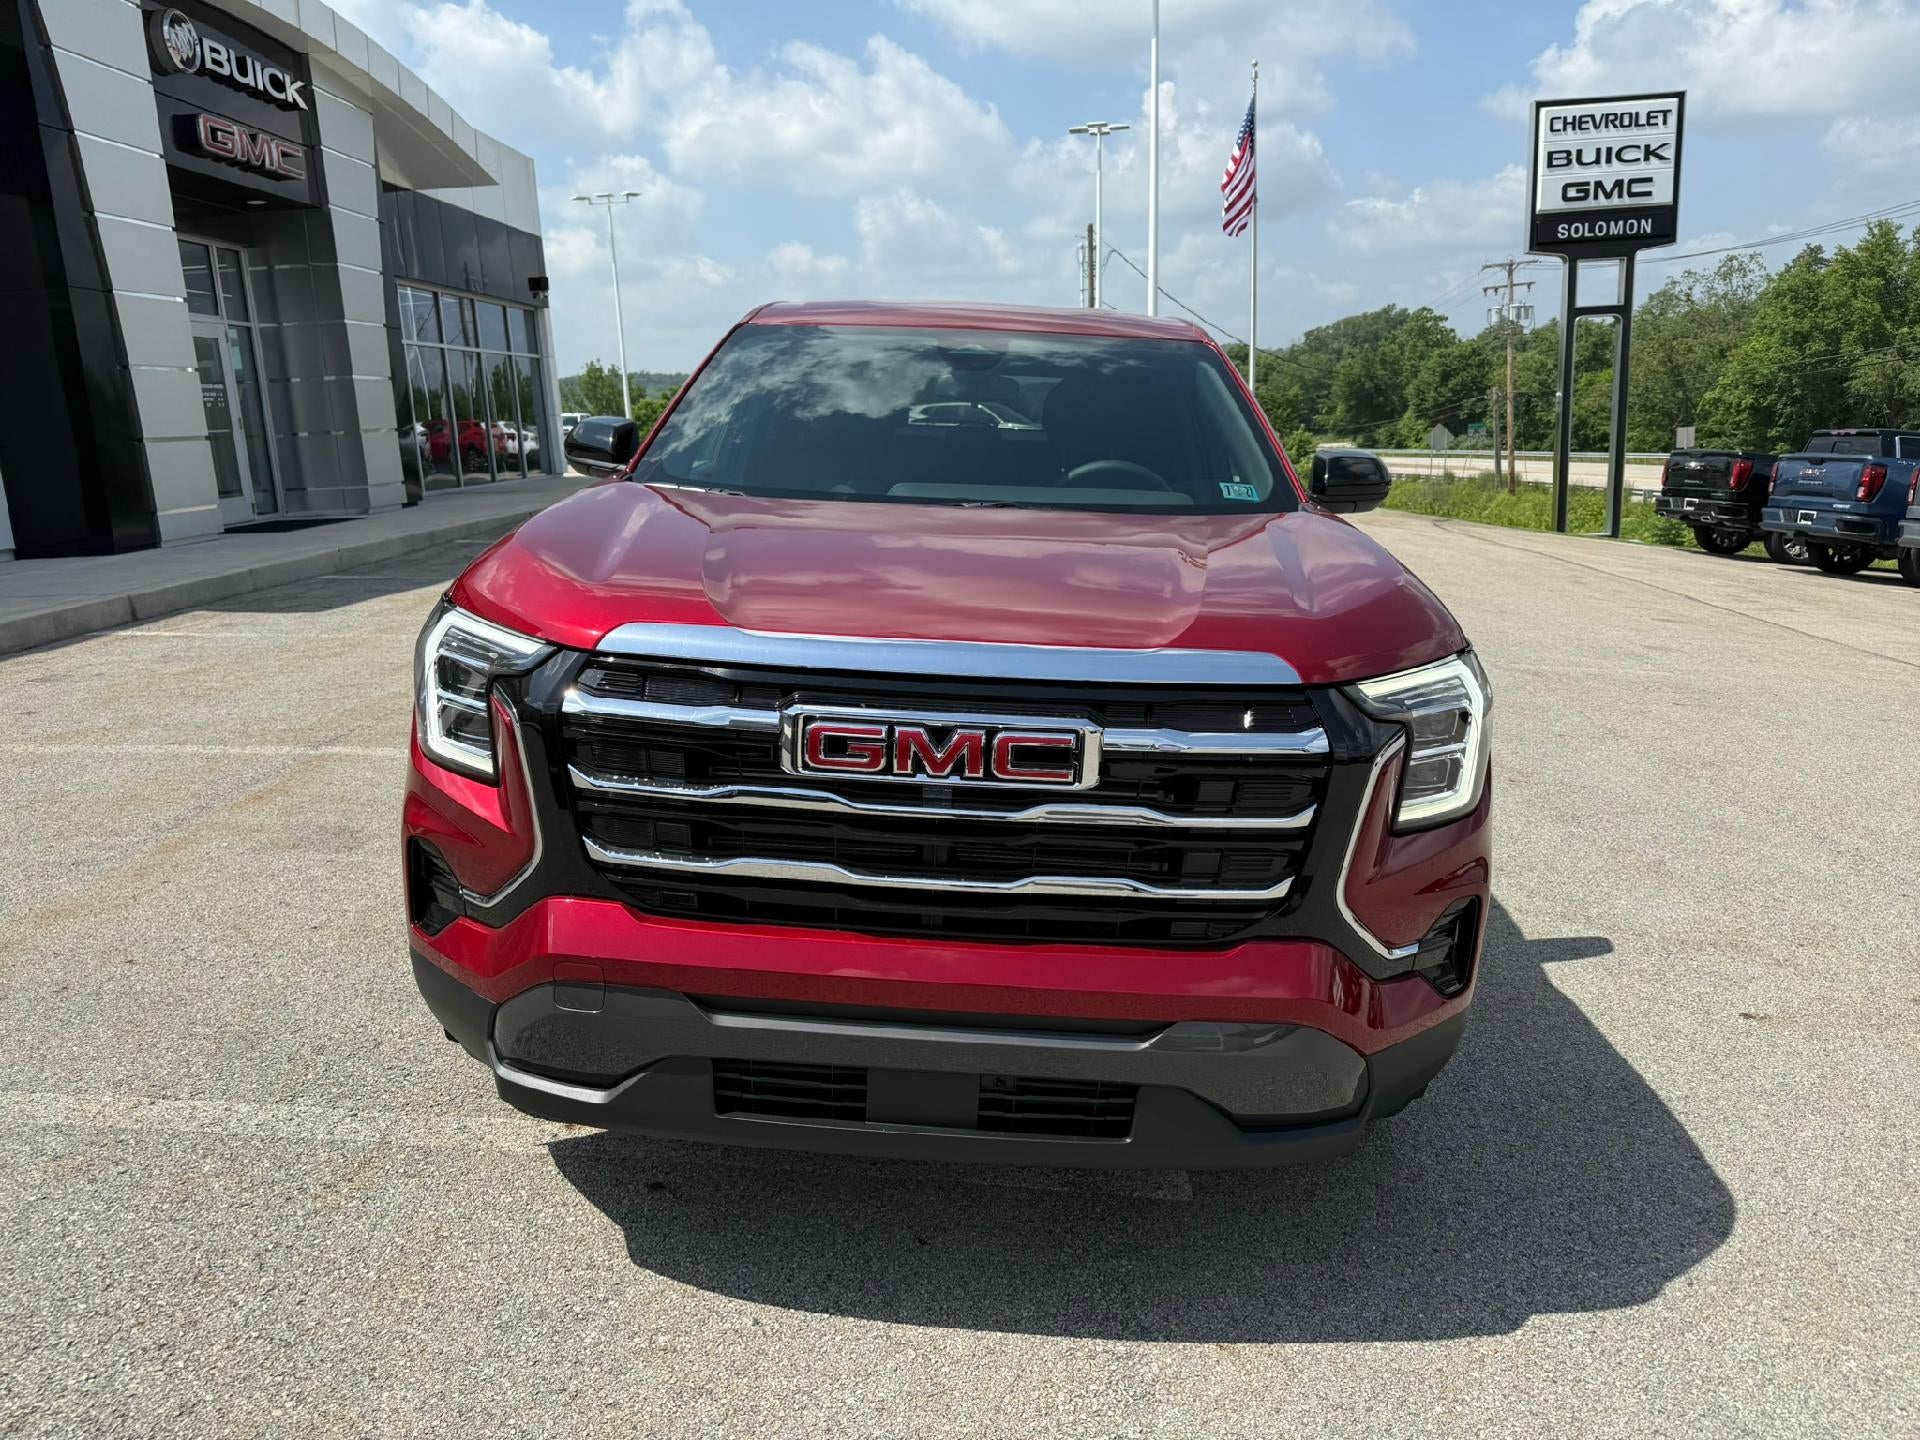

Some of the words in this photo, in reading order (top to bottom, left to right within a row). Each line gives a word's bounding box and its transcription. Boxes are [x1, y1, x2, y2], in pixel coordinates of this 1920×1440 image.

[202, 37, 309, 111] BUICK
[1549, 109, 1672, 133] CHEVROLET
[199, 112, 305, 180] GMC
[1547, 142, 1671, 168] BUICK
[1561, 177, 1653, 203] GMC
[1557, 218, 1652, 239] SOLOMON
[804, 711, 1077, 783] GMC
